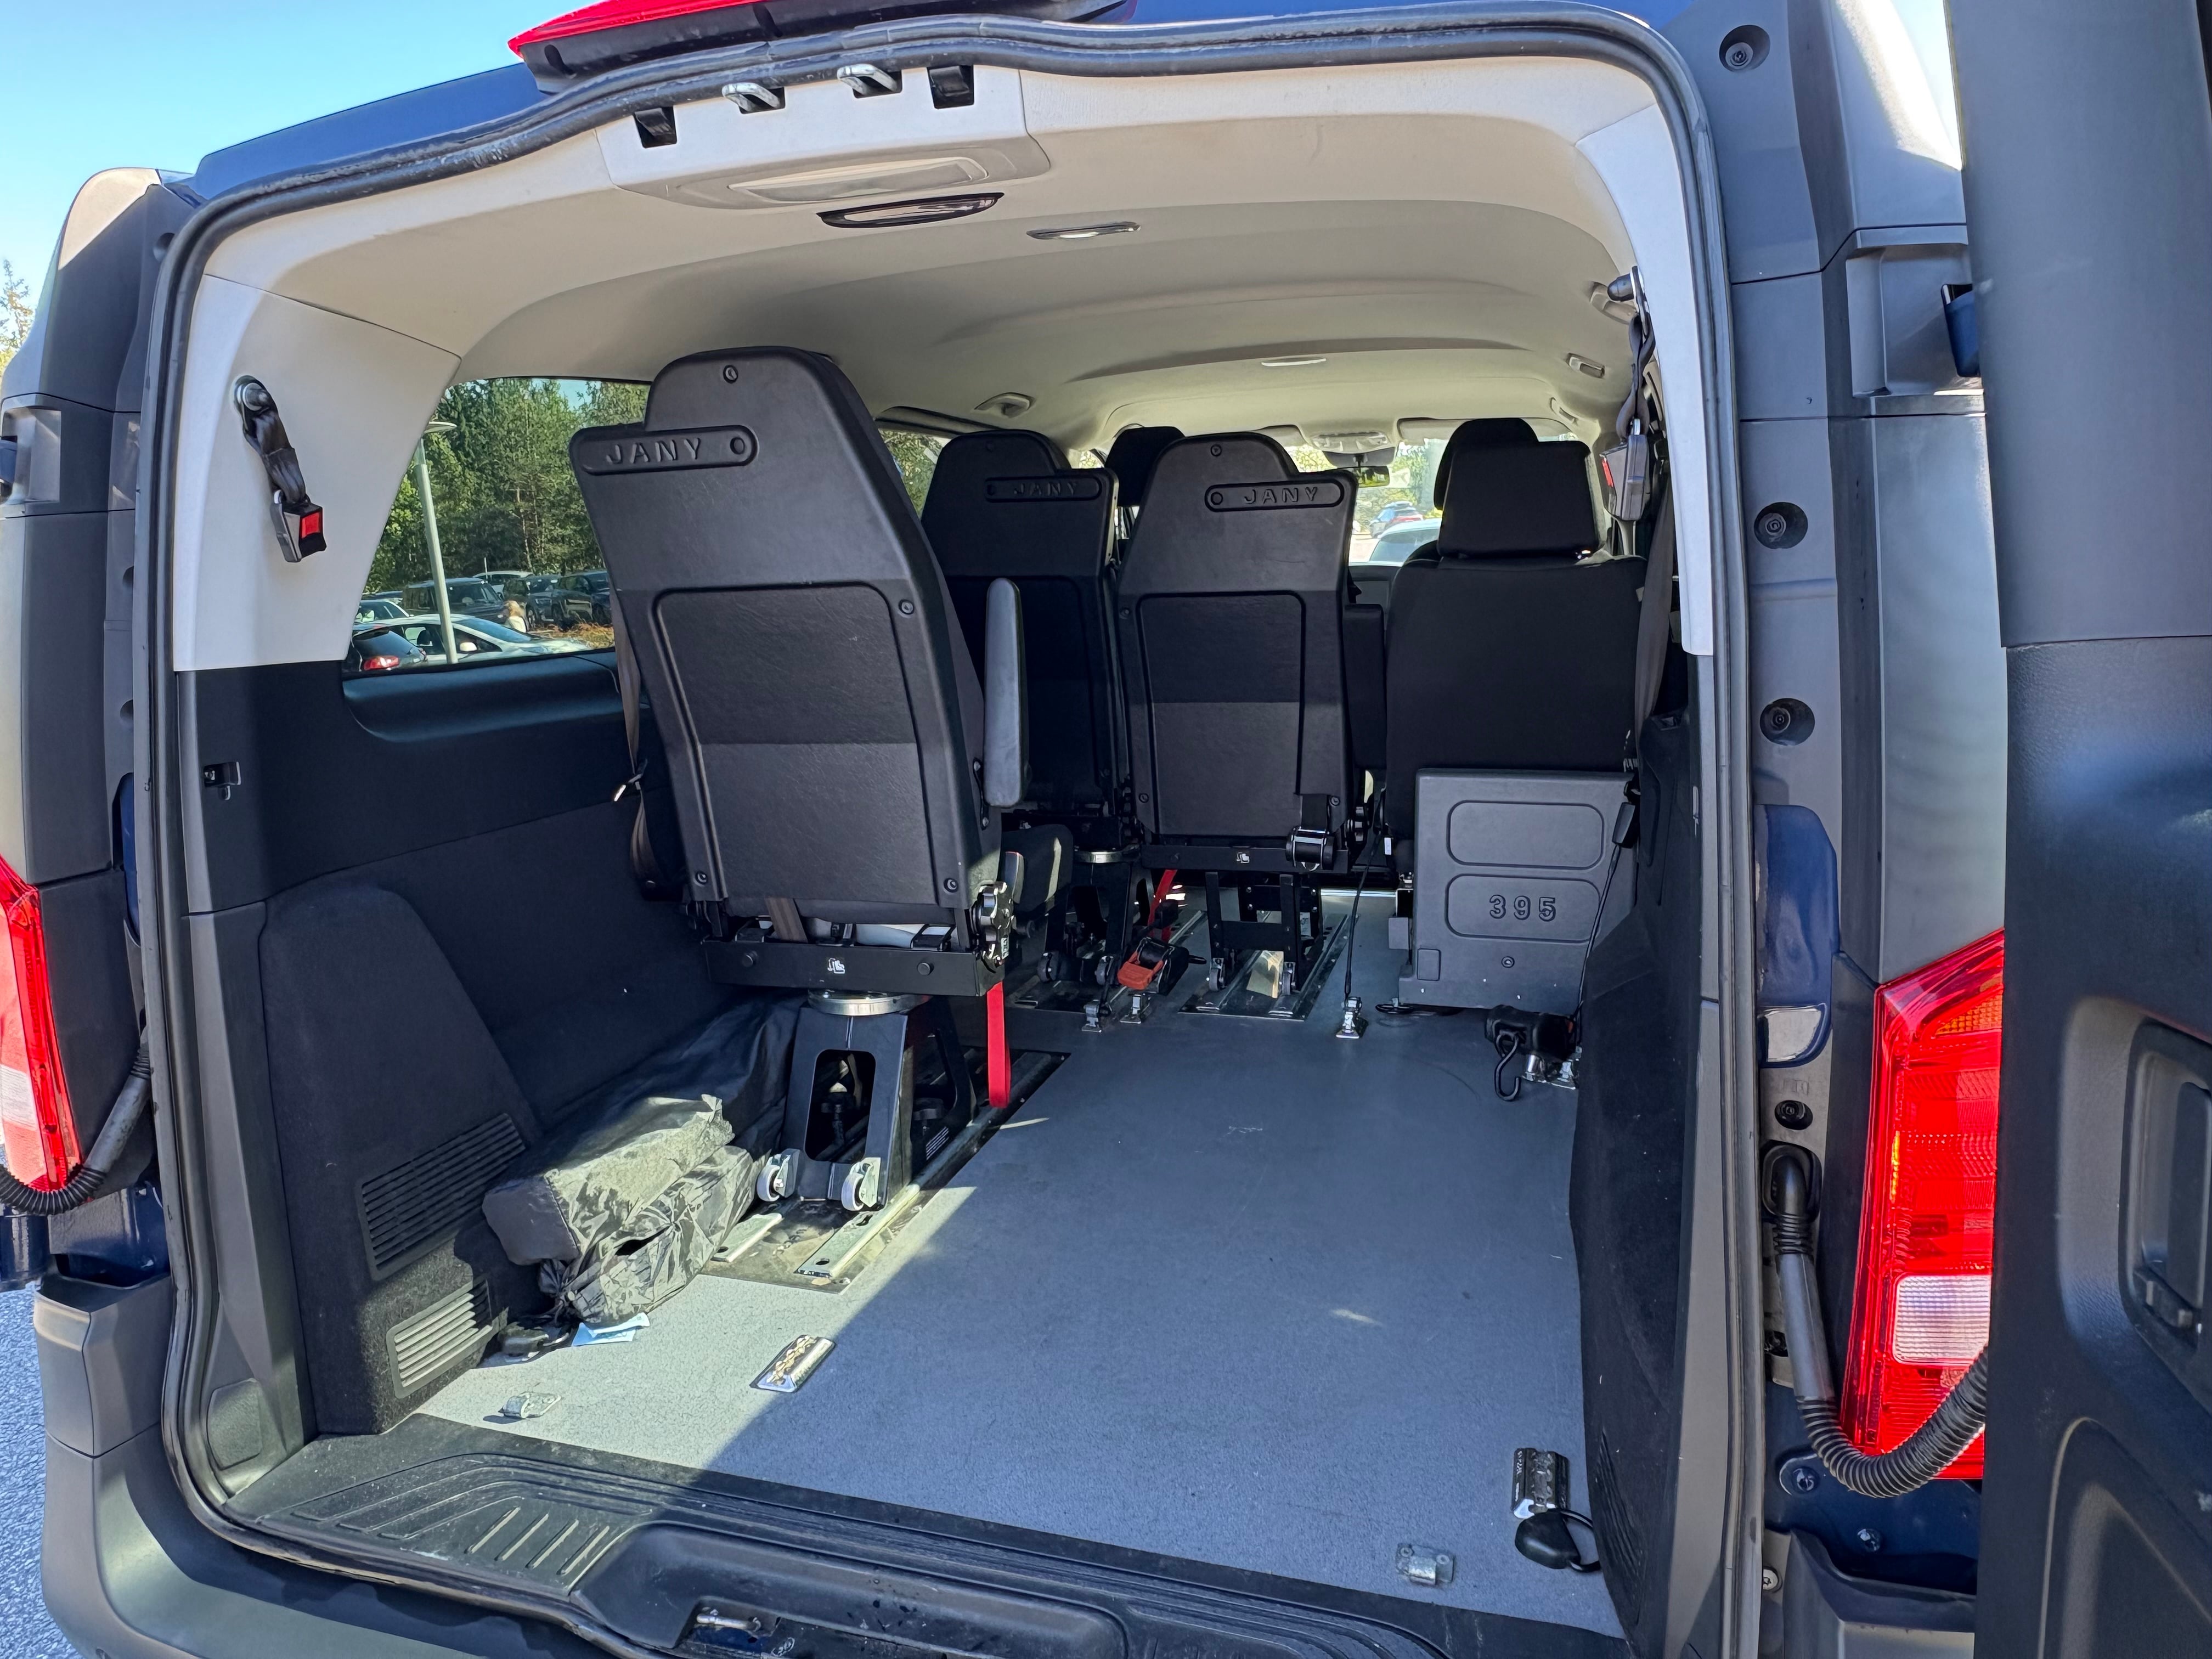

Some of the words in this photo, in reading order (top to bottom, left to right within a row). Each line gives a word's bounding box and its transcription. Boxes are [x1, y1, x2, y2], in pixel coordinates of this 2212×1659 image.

[606, 438, 701, 464] JANY
[1014, 482, 1077, 496] JANY
[1244, 487, 1318, 504] JANY
[1489, 894, 1556, 922] 395
